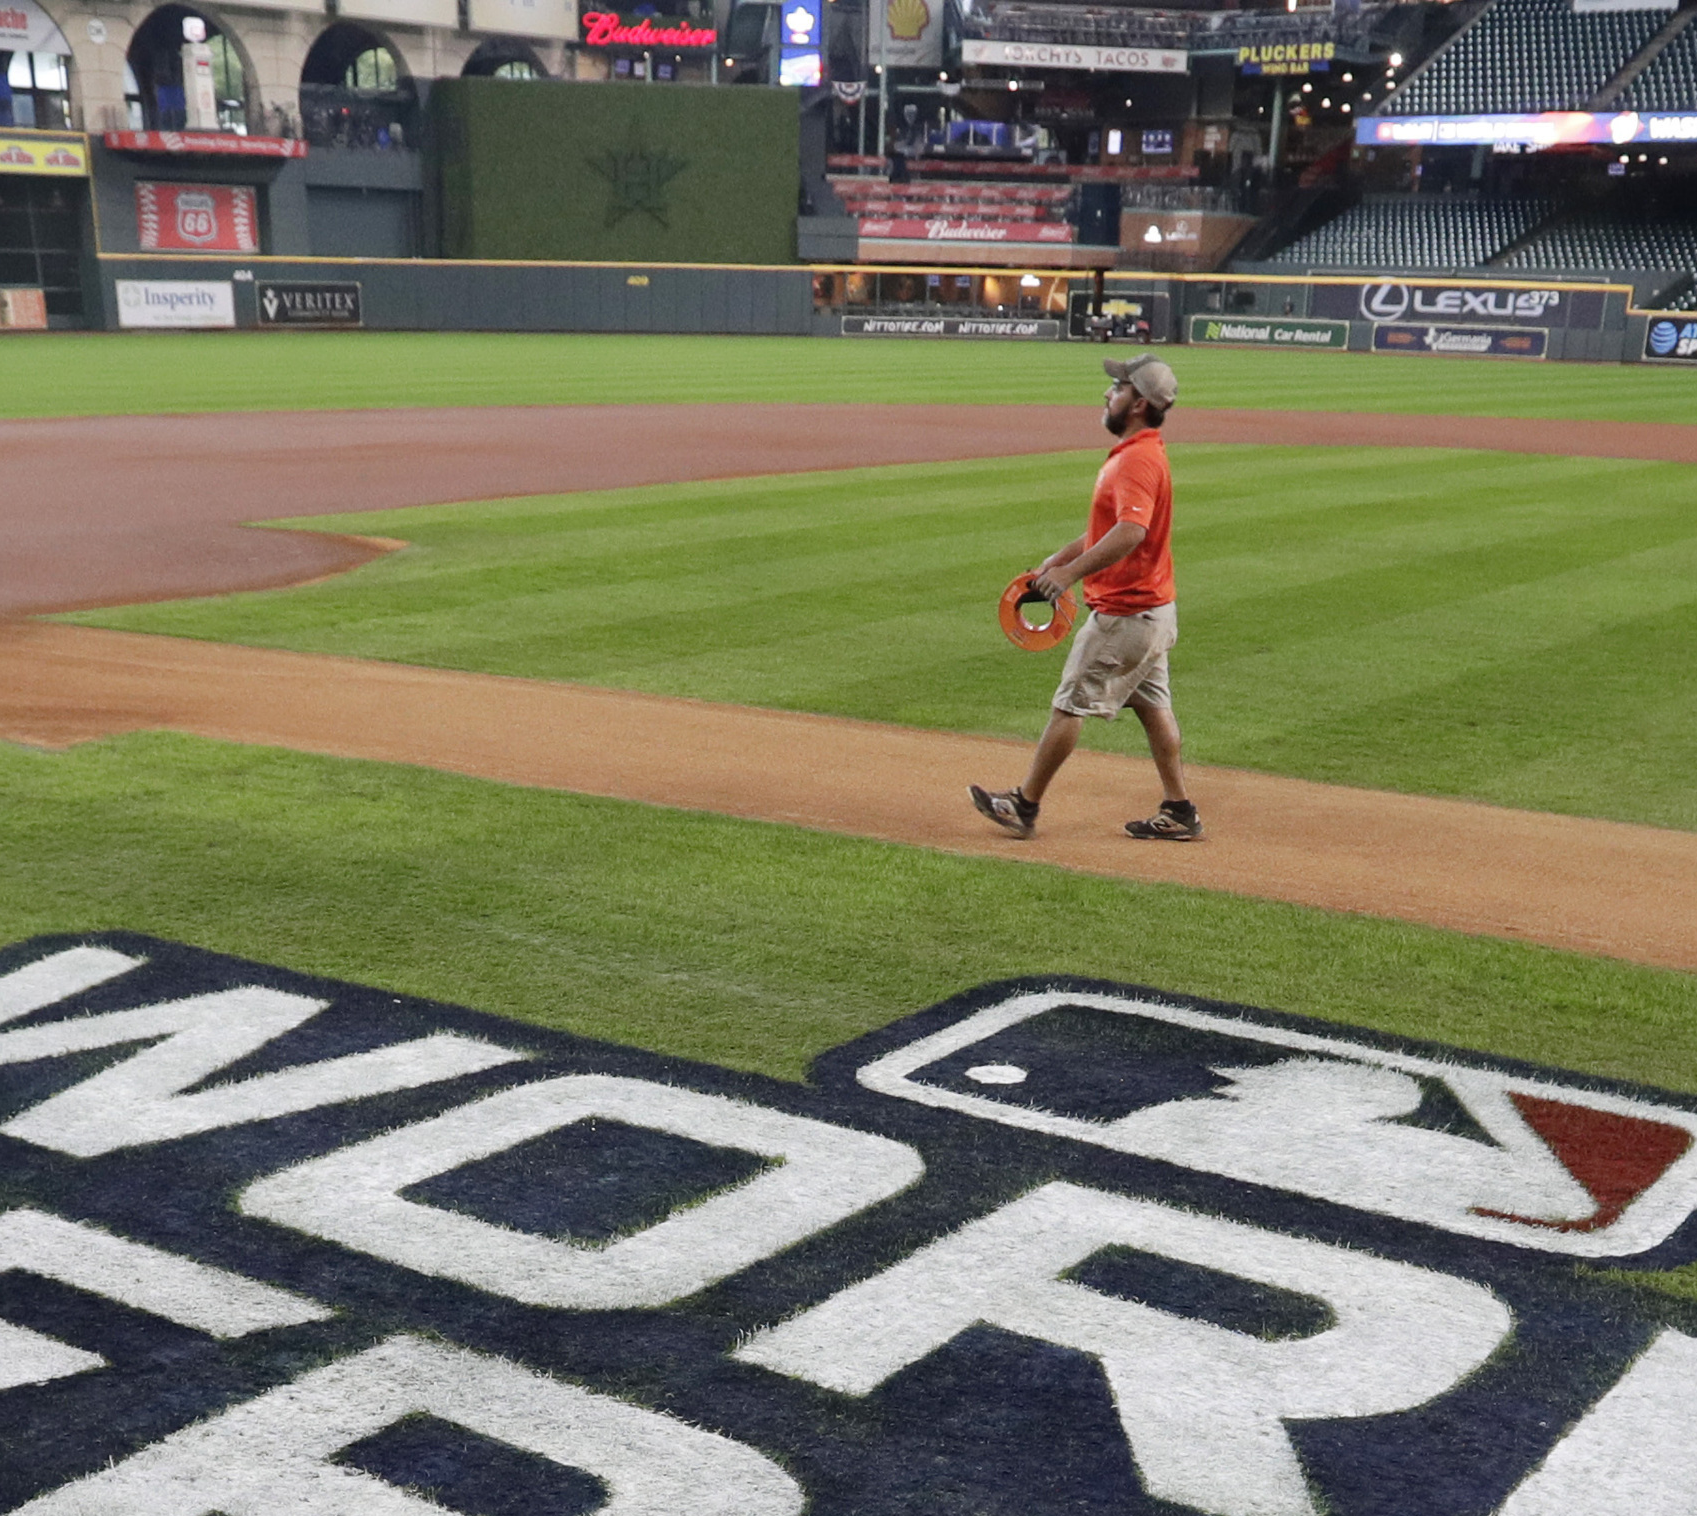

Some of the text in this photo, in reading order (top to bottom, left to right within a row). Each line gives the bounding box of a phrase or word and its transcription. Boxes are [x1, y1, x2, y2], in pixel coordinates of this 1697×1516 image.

[582, 11, 717, 46] Budweiser
[1096, 49, 1150, 67] TACOS
[1238, 42, 1336, 62] PLUCKERS
[183, 212, 209, 233] 66
[925, 220, 1007, 239] Budweiser
[144, 286, 217, 311] Insperity
[282, 292, 355, 310] VERITEX
[1413, 289, 1544, 318] LEXUS
[1529, 291, 1560, 307] 373
[1220, 323, 1332, 343] National Car Rental
